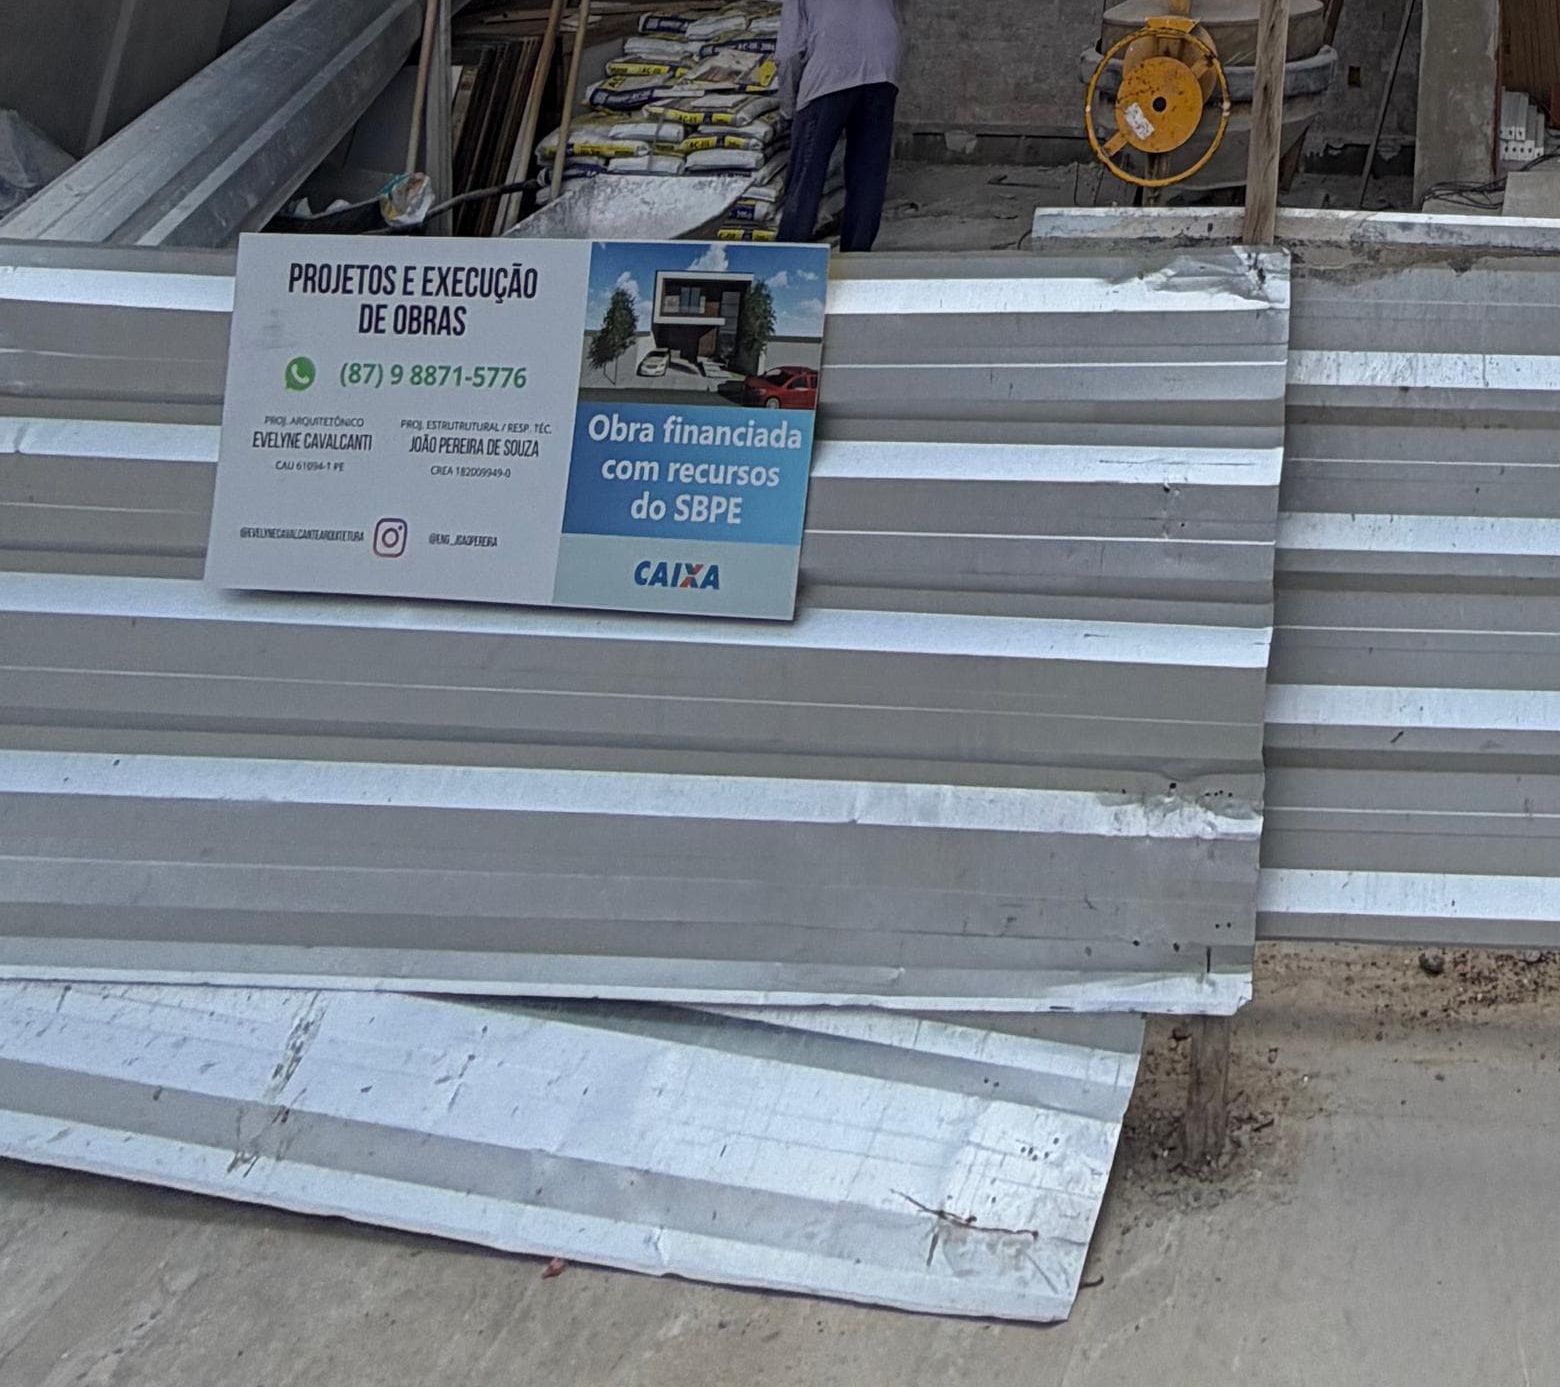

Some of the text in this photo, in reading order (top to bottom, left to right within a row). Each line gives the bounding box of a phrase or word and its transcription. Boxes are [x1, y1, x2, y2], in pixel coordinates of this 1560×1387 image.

[288, 262, 539, 304] PROJETOS E EXECUÇÃO
[358, 303, 467, 336] DE OBRAS
[340, 362, 527, 389] (87) 9 8871-5776
[264, 414, 365, 428] PROJ. ARQUITETÔNICO
[400, 419, 424, 431] PROJ.
[588, 413, 803, 450] Obra financiada
[252, 430, 373, 451] EVELYNE CAVALCANTI
[408, 433, 540, 458] JOÃO PEREIRA DE SOUZA
[275, 459, 295, 471] CAU
[430, 465, 454, 476] CREA
[601, 458, 781, 488] com recursos
[630, 490, 743, 524] do SBPE
[633, 560, 721, 590] CAIXA
